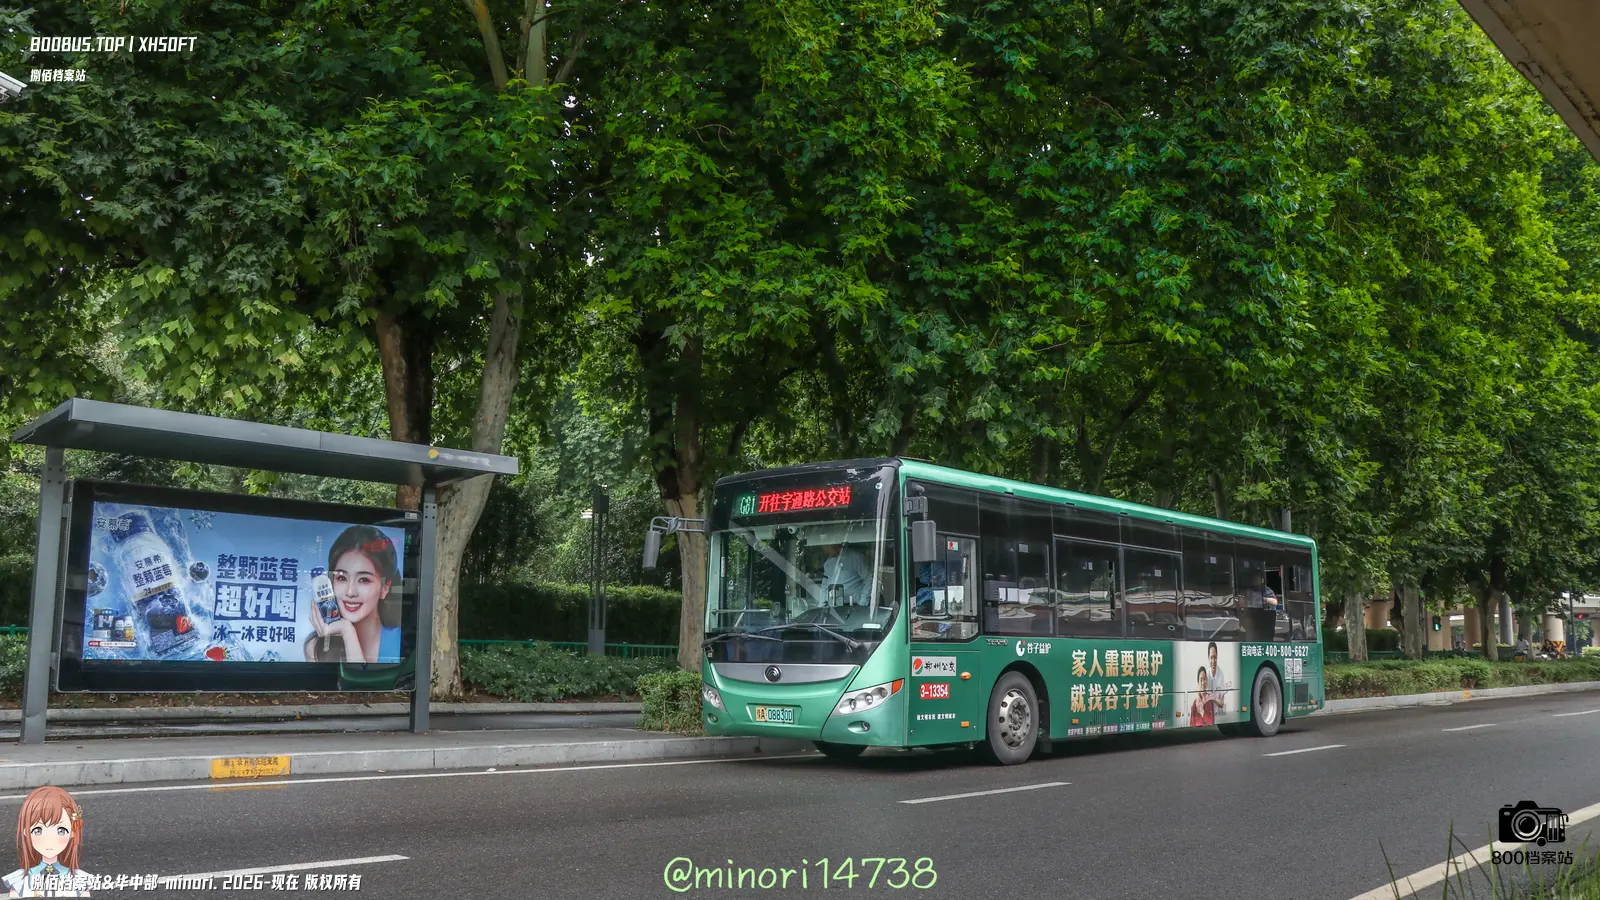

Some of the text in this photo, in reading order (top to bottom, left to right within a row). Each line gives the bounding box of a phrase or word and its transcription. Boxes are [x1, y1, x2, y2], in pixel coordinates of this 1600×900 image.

[758, 486, 851, 512] 开往宇通路公交站
[132, 563, 173, 589] 整颗蓝莓
[216, 553, 298, 583] 整颗蓝莓
[215, 584, 295, 620] 超好喝
[212, 624, 296, 643] 冰一冰更好喝
[1071, 649, 1164, 678] 家人需要照护
[1265, 645, 1309, 657] 400-800-6627
[924, 661, 956, 673] 郑州公交
[920, 684, 949, 698] 3-13354
[1070, 682, 1164, 713] 就找谷子益护
